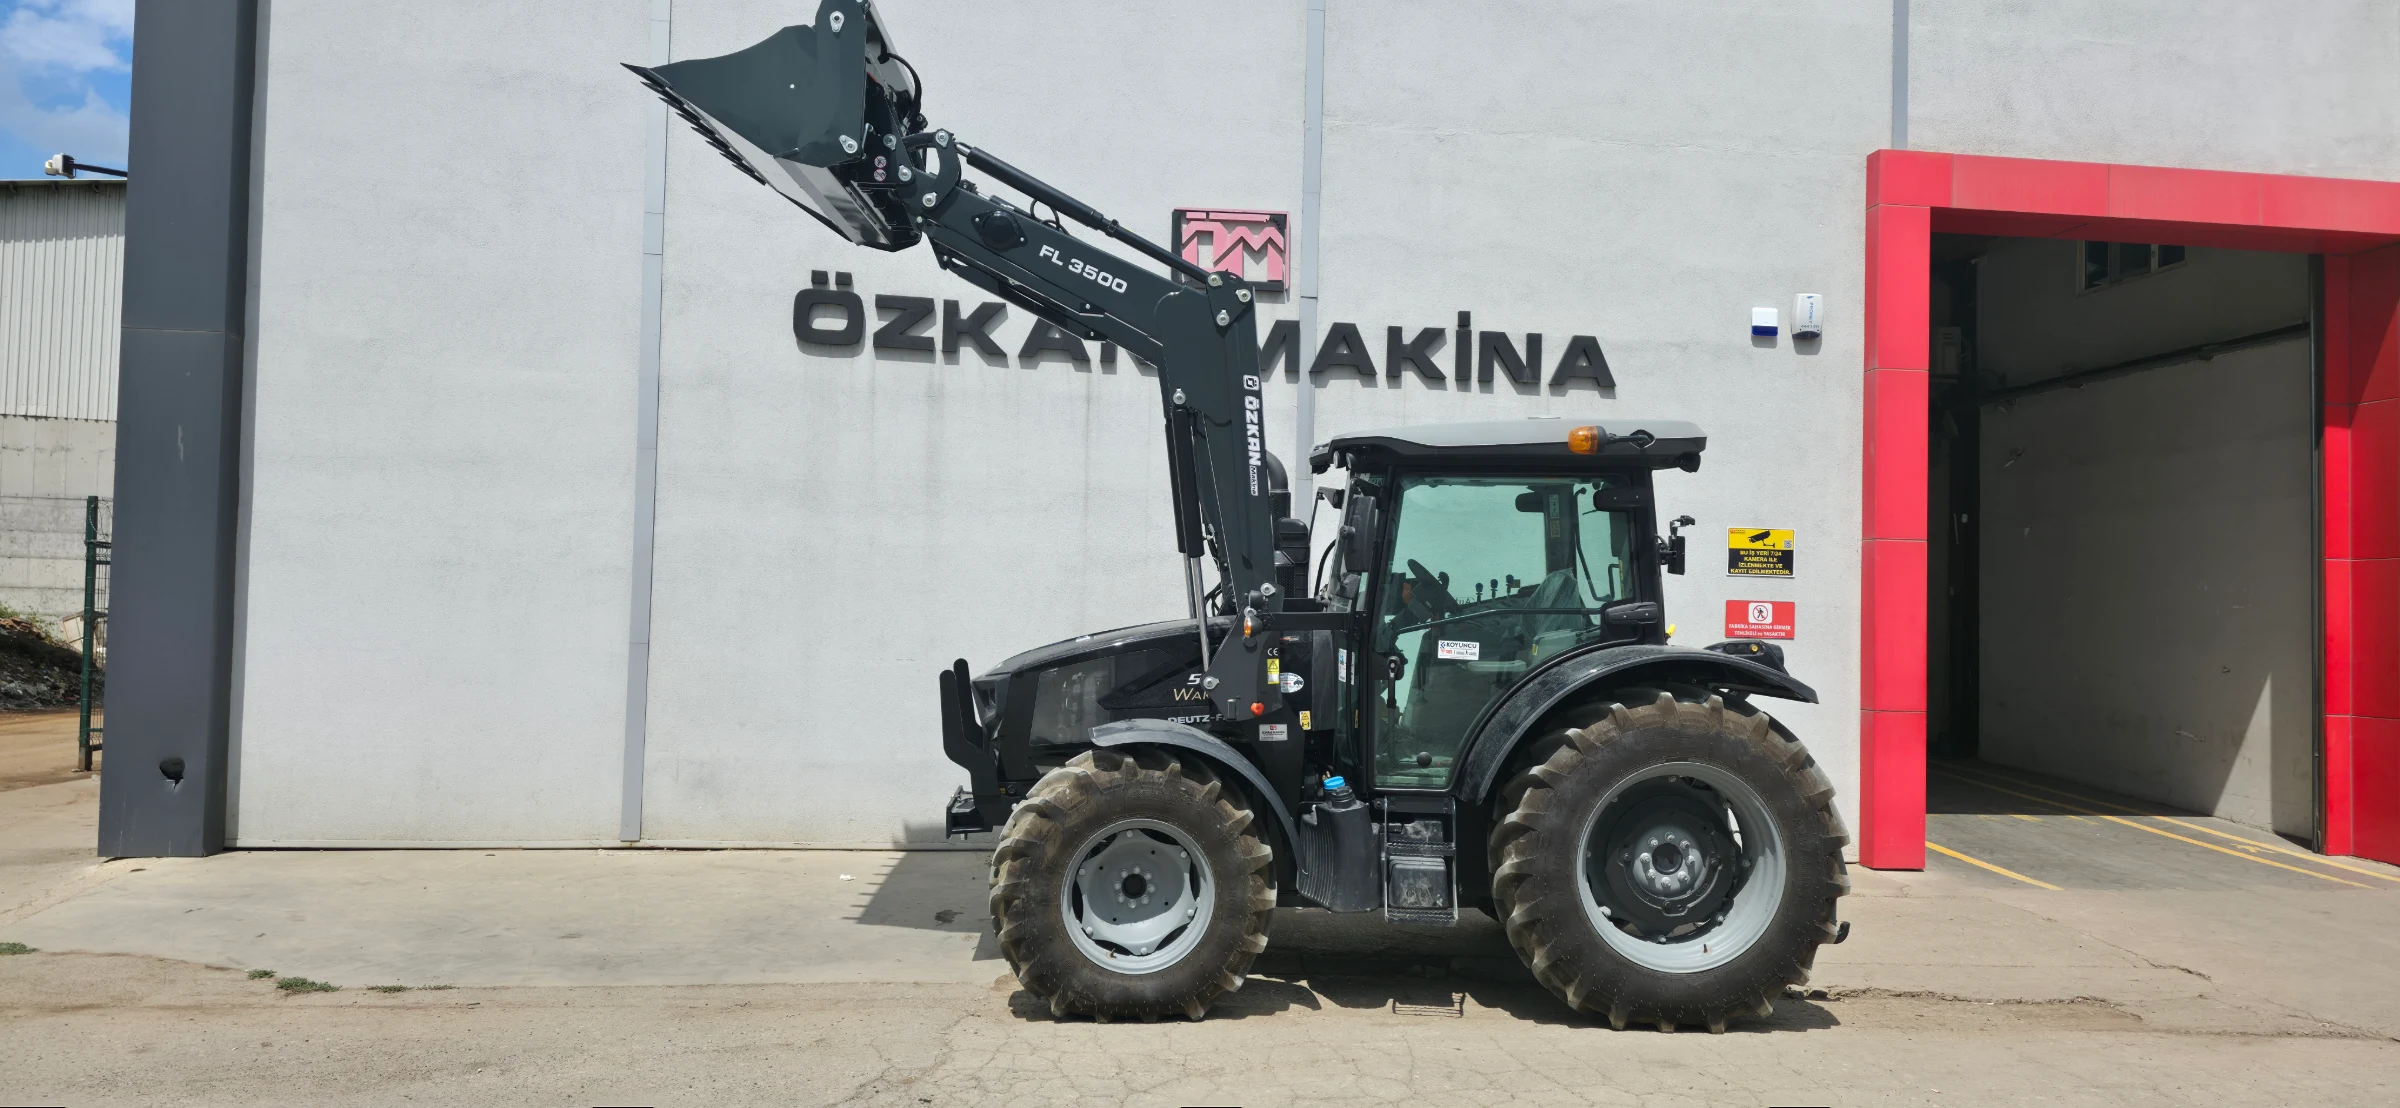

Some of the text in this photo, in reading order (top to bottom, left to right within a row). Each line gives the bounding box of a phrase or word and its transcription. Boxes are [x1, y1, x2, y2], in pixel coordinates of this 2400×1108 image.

[1039, 244, 1128, 294] FL 3500
[1244, 395, 1261, 466] ÖZKAN
